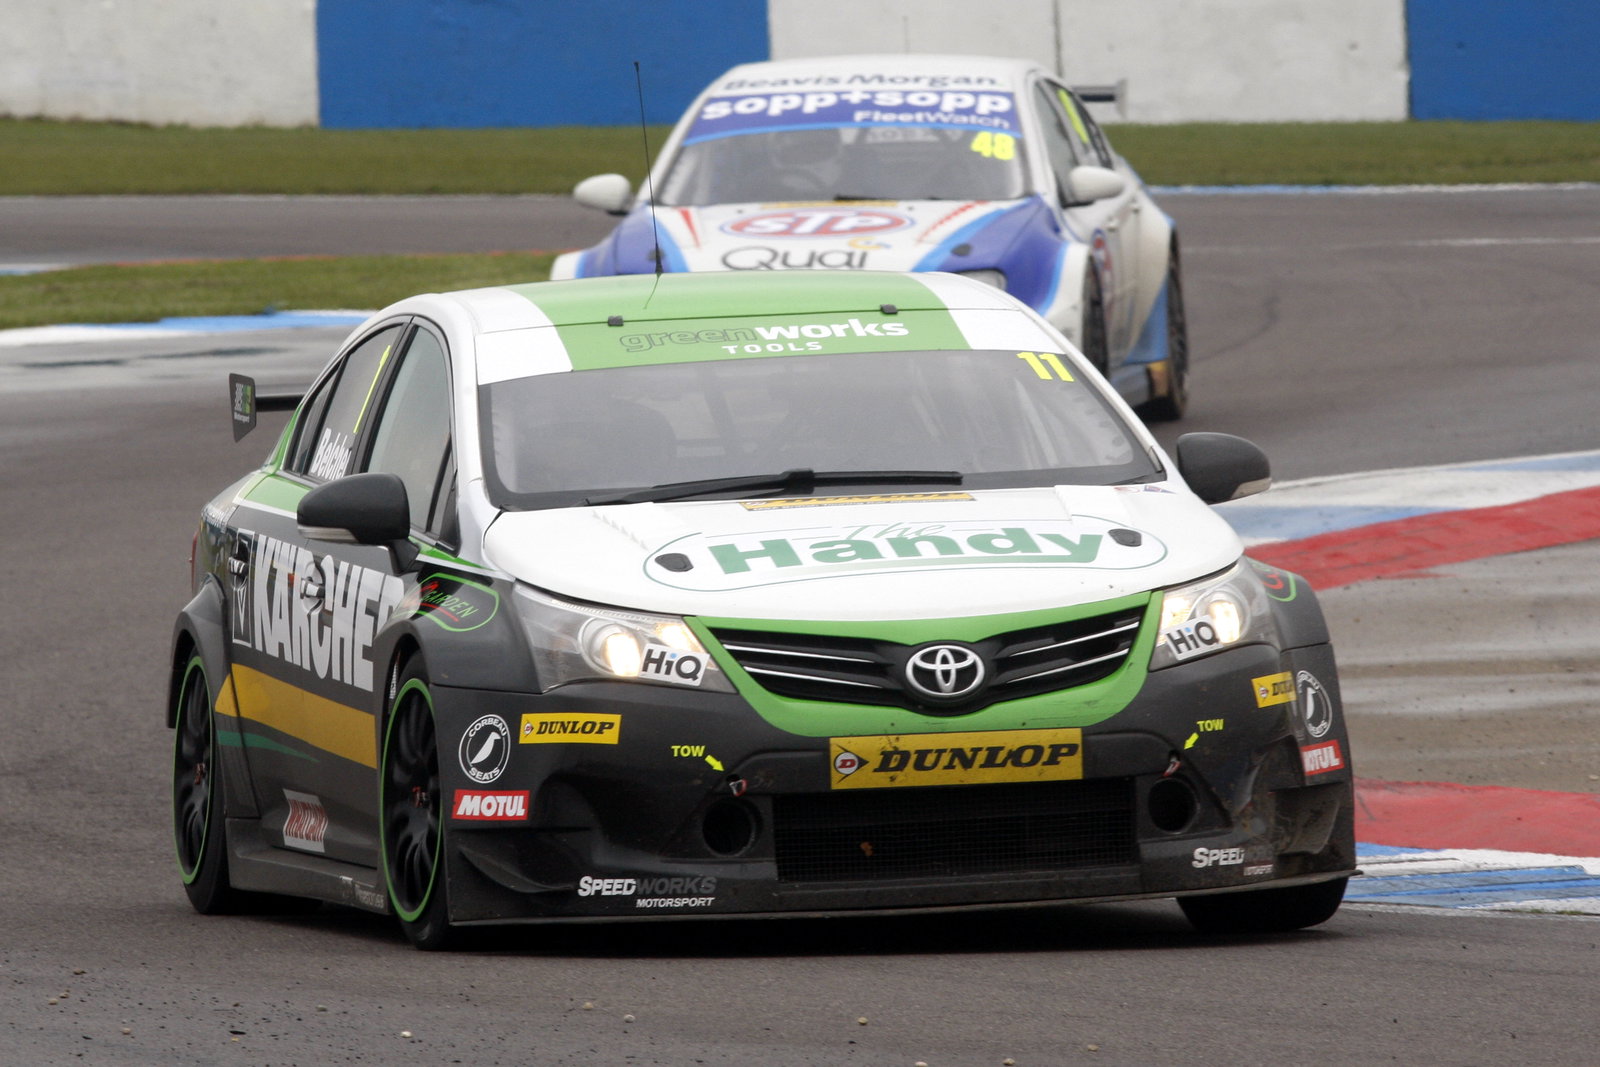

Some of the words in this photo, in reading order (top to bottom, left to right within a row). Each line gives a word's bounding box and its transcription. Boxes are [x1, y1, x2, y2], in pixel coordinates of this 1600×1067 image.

[848, 73, 999, 89] Morgan
[853, 110, 1010, 129] FleetWatch
[970, 131, 1016, 160] 48
[743, 210, 891, 234] STP
[619, 318, 910, 352] greenworks
[721, 342, 823, 355] TOOLS
[1015, 351, 1075, 382] 11
[708, 527, 1103, 574] Handy
[1165, 621, 1220, 654] HiQ
[641, 648, 702, 682] HiQ
[468, 717, 508, 738] CORBEAU
[536, 720, 615, 735] DUNLOP
[1197, 718, 1224, 732] TOW
[671, 745, 705, 757] TOW
[873, 743, 1080, 773] DUNLOP
[468, 767, 501, 782] SEATS
[456, 795, 526, 817] MOTUL
[636, 897, 715, 908] MOTORSPORT
